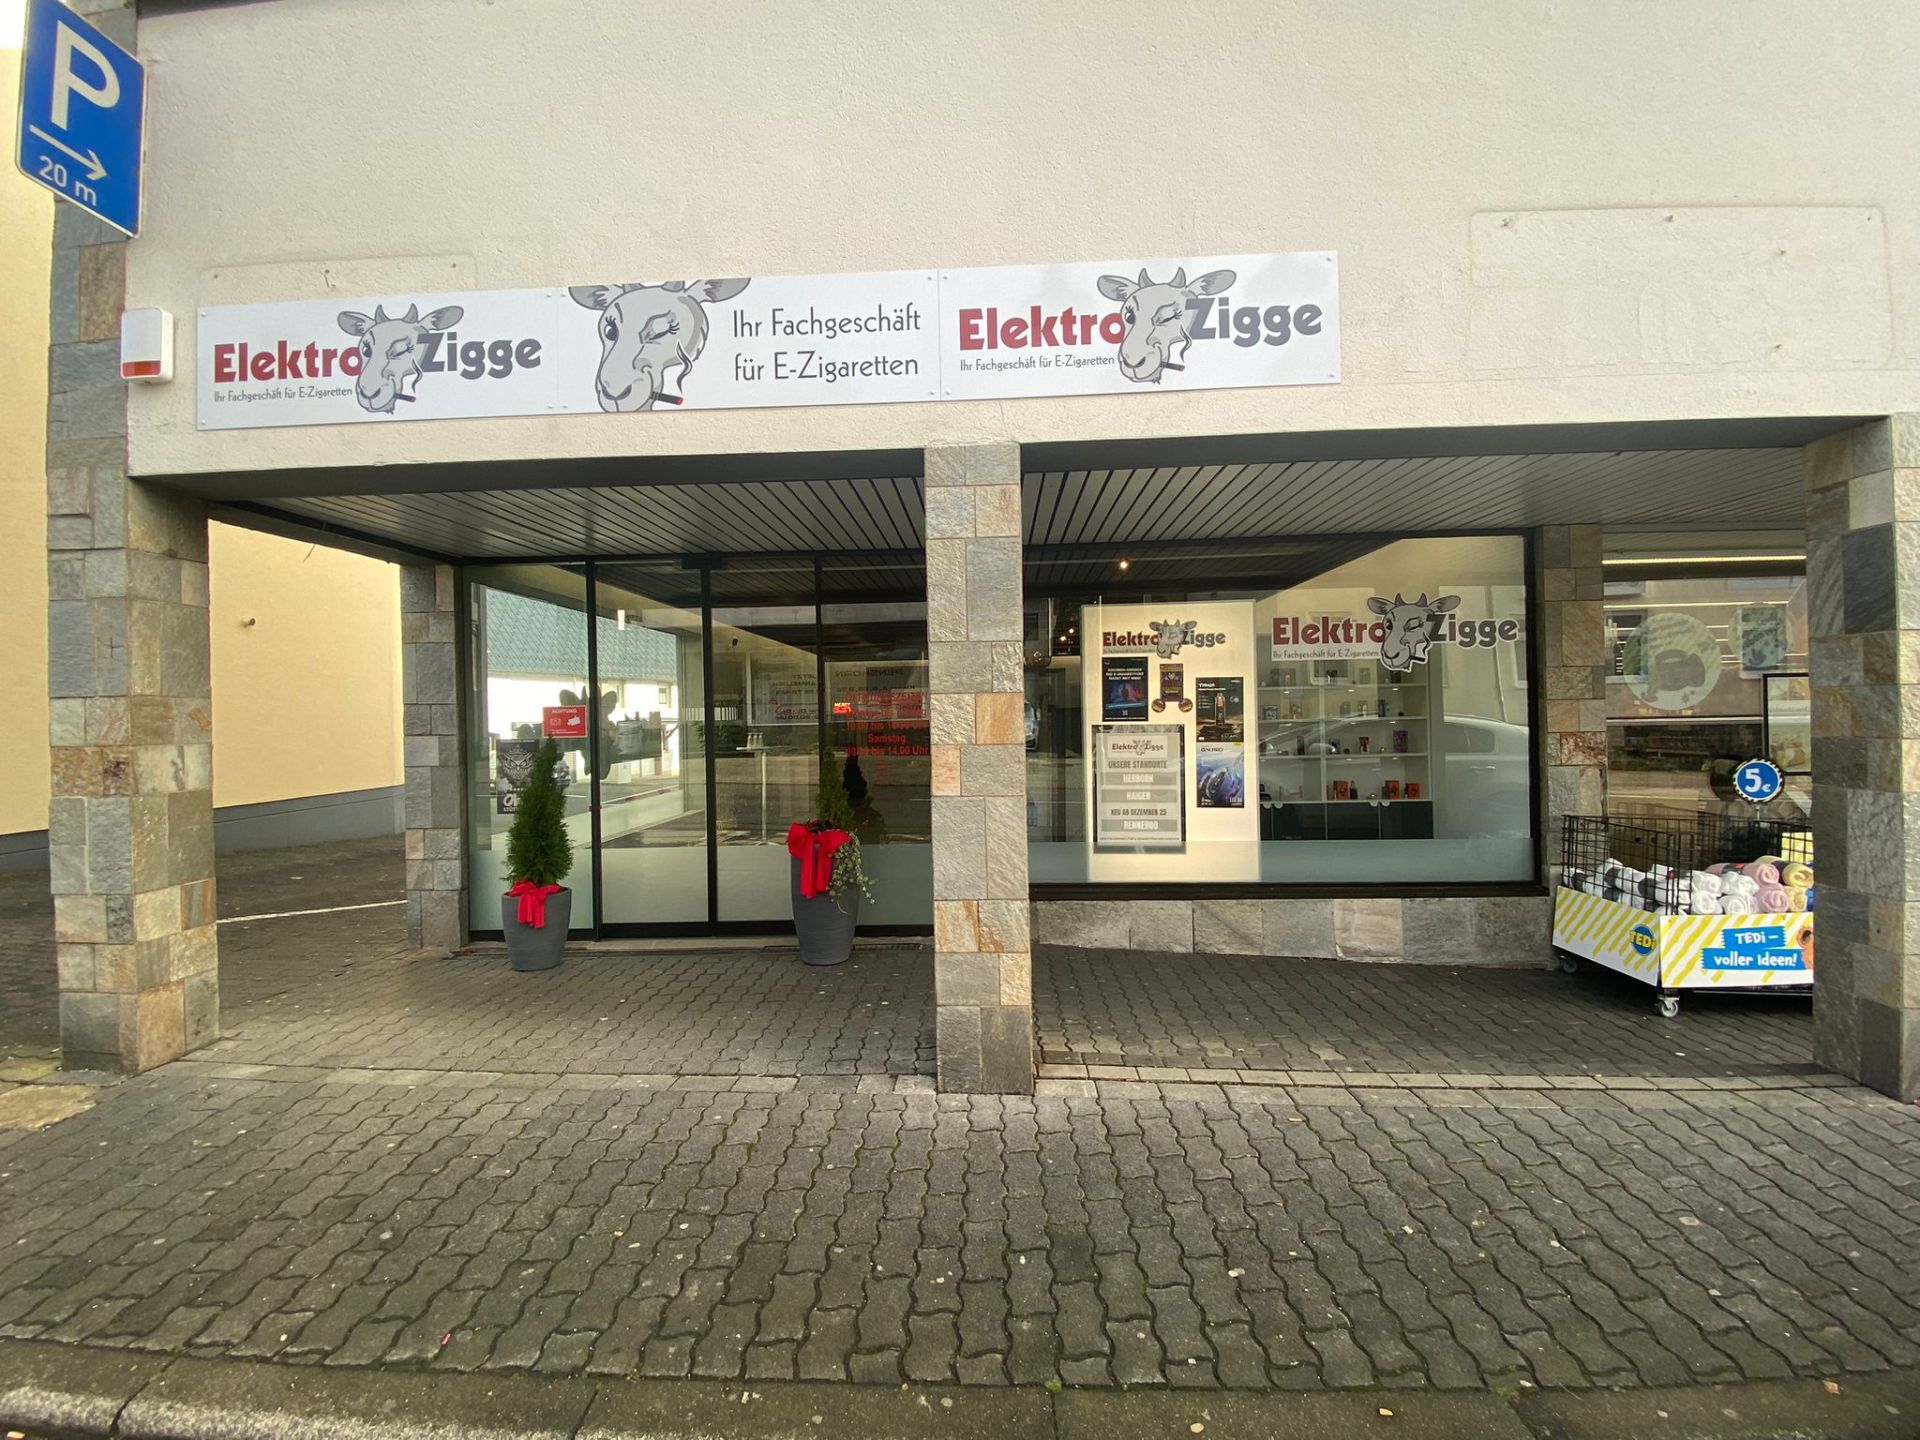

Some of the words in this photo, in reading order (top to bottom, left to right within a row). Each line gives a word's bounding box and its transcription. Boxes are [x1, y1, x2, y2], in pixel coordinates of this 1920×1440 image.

[51, 20, 121, 131] P
[39, 155, 68, 188] 20
[75, 180, 97, 207] m
[733, 309, 763, 338] Ihr
[772, 302, 921, 340] Fachgeschäft
[959, 305, 1127, 350] Elektro
[1185, 297, 1323, 348] Zigge
[214, 340, 363, 383] Elektro
[417, 331, 543, 380] Zigge
[960, 359, 972, 371] Ihr
[976, 356, 1036, 372] Fachgeschäft
[1039, 355, 1052, 368] für
[1055, 354, 1115, 368] E-Zigaretten
[735, 353, 765, 381] für
[774, 350, 919, 384] E-Zigaretten
[214, 391, 226, 402] Ihr
[228, 388, 282, 403] Fachgeschäft
[284, 387, 296, 399] für
[298, 386, 353, 399] E-Zigaretten
[1102, 631, 1159, 647] Elektro
[1182, 630, 1226, 648] Zigge
[1272, 616, 1386, 645] Elektro
[1426, 613, 1518, 648] Zigge
[1283, 649, 1326, 660] Fachgeschäft
[1327, 649, 1336, 658] für
[1108, 761, 1131, 769] UNSERE
[1132, 761, 1168, 769] STANDORTE
[1131, 808, 1158, 816] DEZEMBER
[1734, 932, 1766, 944] TEDi
[1714, 951, 1753, 966] voller
[1757, 951, 1797, 967] Ideen!
